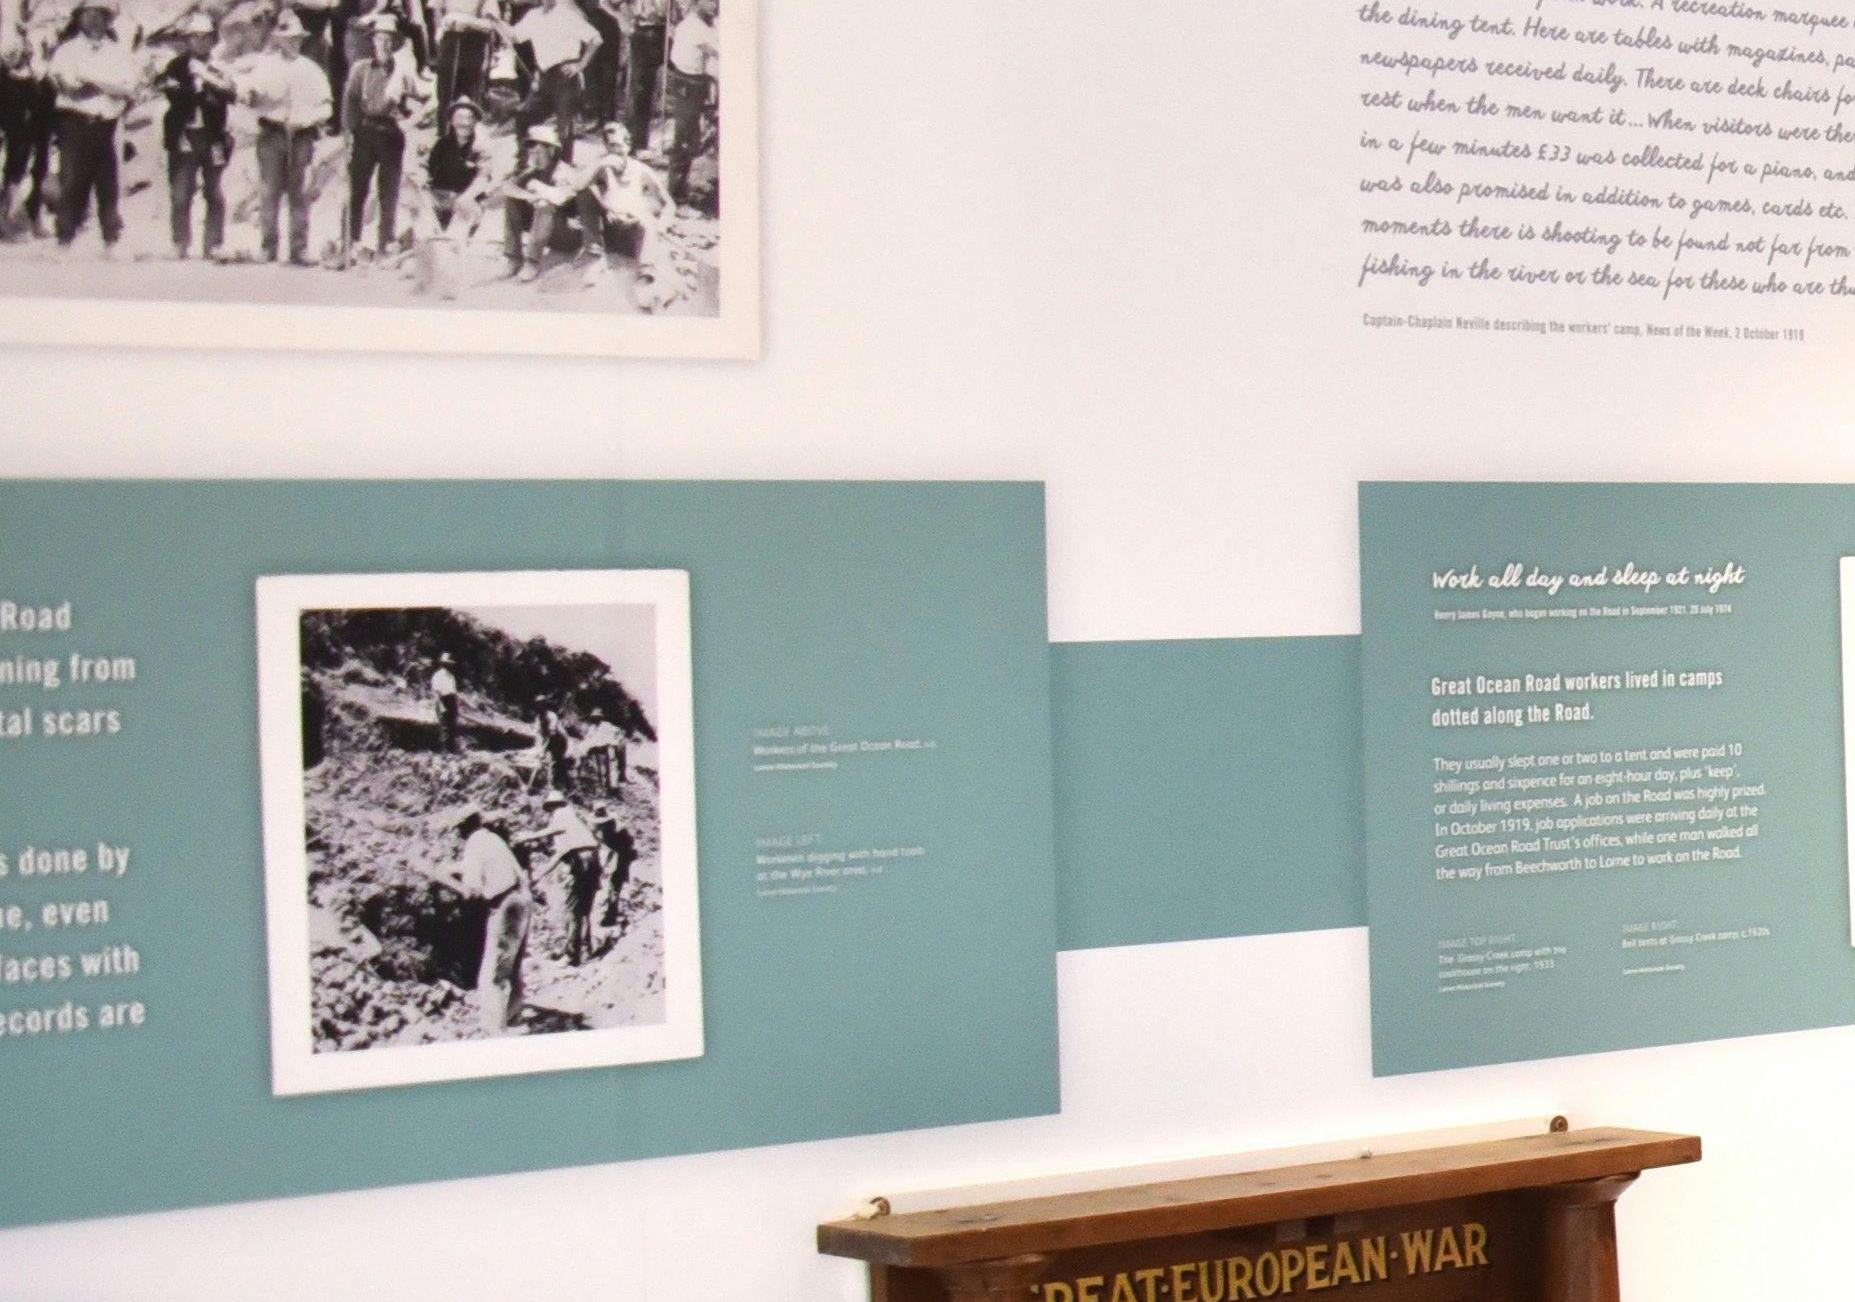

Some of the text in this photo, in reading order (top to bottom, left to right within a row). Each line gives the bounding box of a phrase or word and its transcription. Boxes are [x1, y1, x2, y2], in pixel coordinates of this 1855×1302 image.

[1432, 562, 1746, 596] Work all day and sleep at night
[0, 601, 71, 632] Road
[70, 653, 136, 683] from
[1431, 669, 1723, 697] Great Ocean Road workers lived in camps
[42, 707, 122, 738] scars
[1432, 703, 1595, 727] dotted along the Road.
[18, 840, 131, 878] done by
[42, 897, 110, 929] even
[80, 944, 141, 978] with
[98, 999, 146, 1029] are
